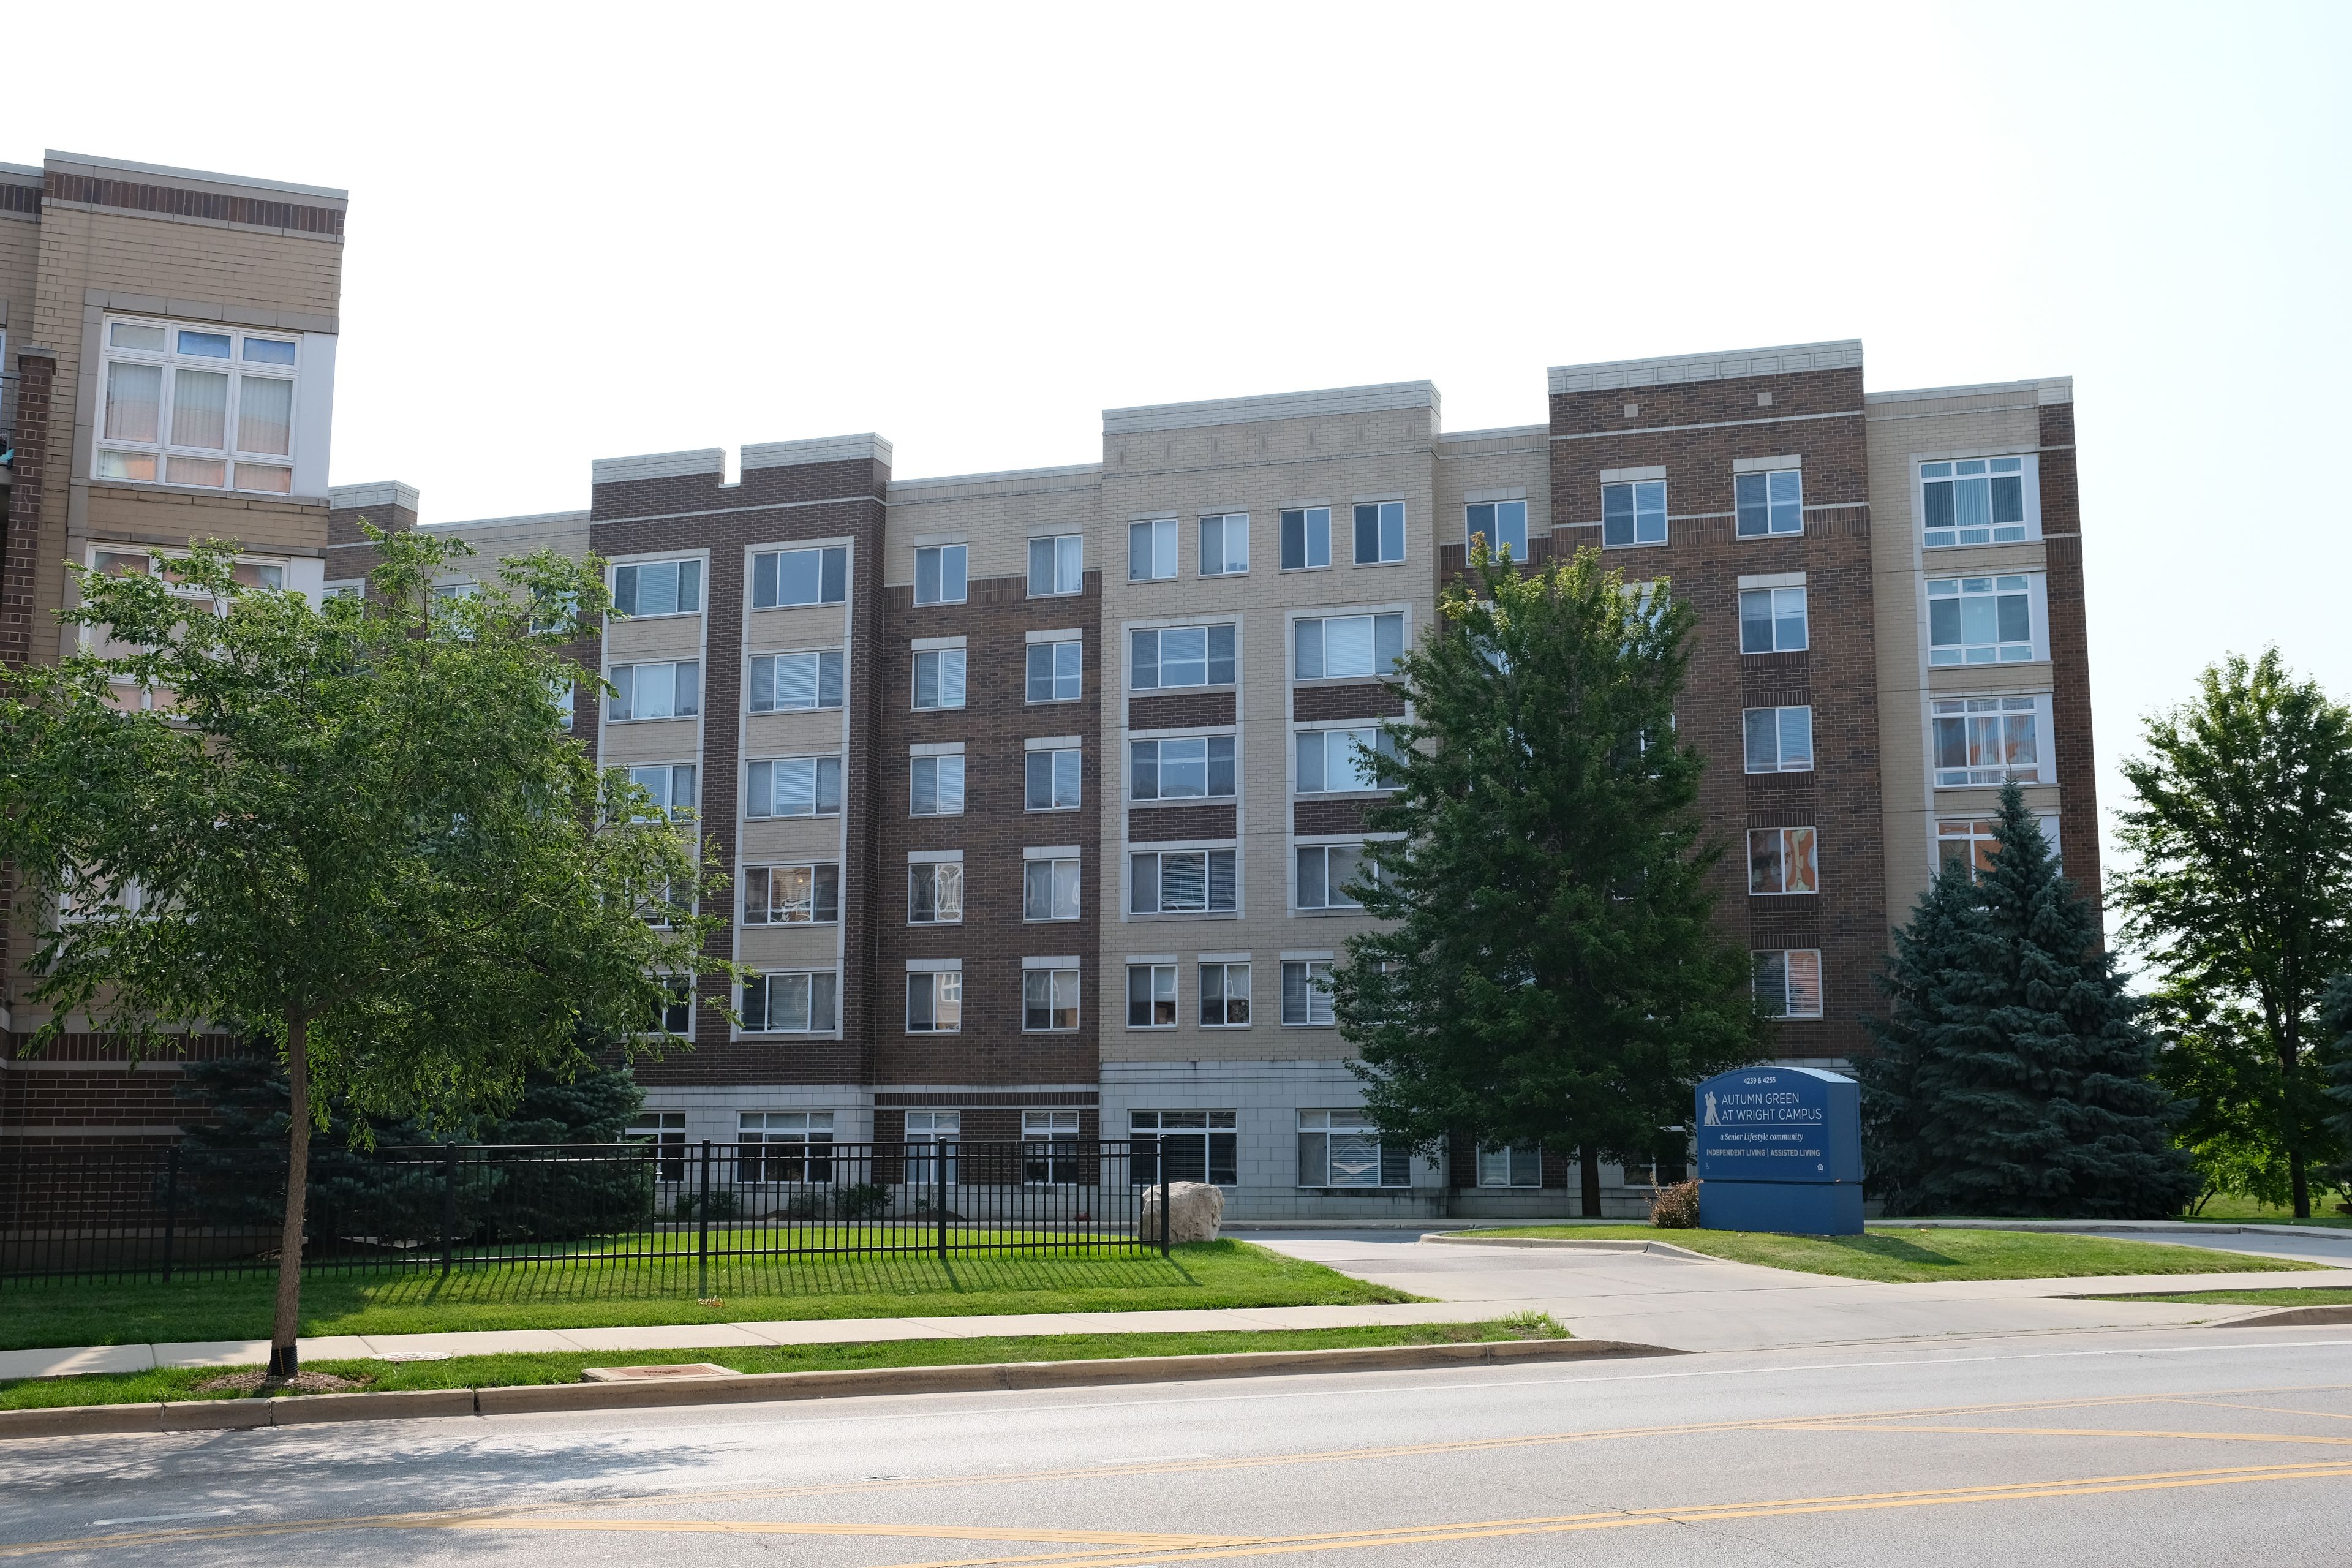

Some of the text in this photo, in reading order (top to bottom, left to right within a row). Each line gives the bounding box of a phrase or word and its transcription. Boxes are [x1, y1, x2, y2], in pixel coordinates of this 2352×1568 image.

[1721, 1092, 1800, 1105] AUTUMN GREEN
[1722, 1107, 1822, 1121] AT WRIGHT CAMPUS
[1744, 1132, 1769, 1143] Lifestyle
[1770, 1132, 1804, 1143] community
